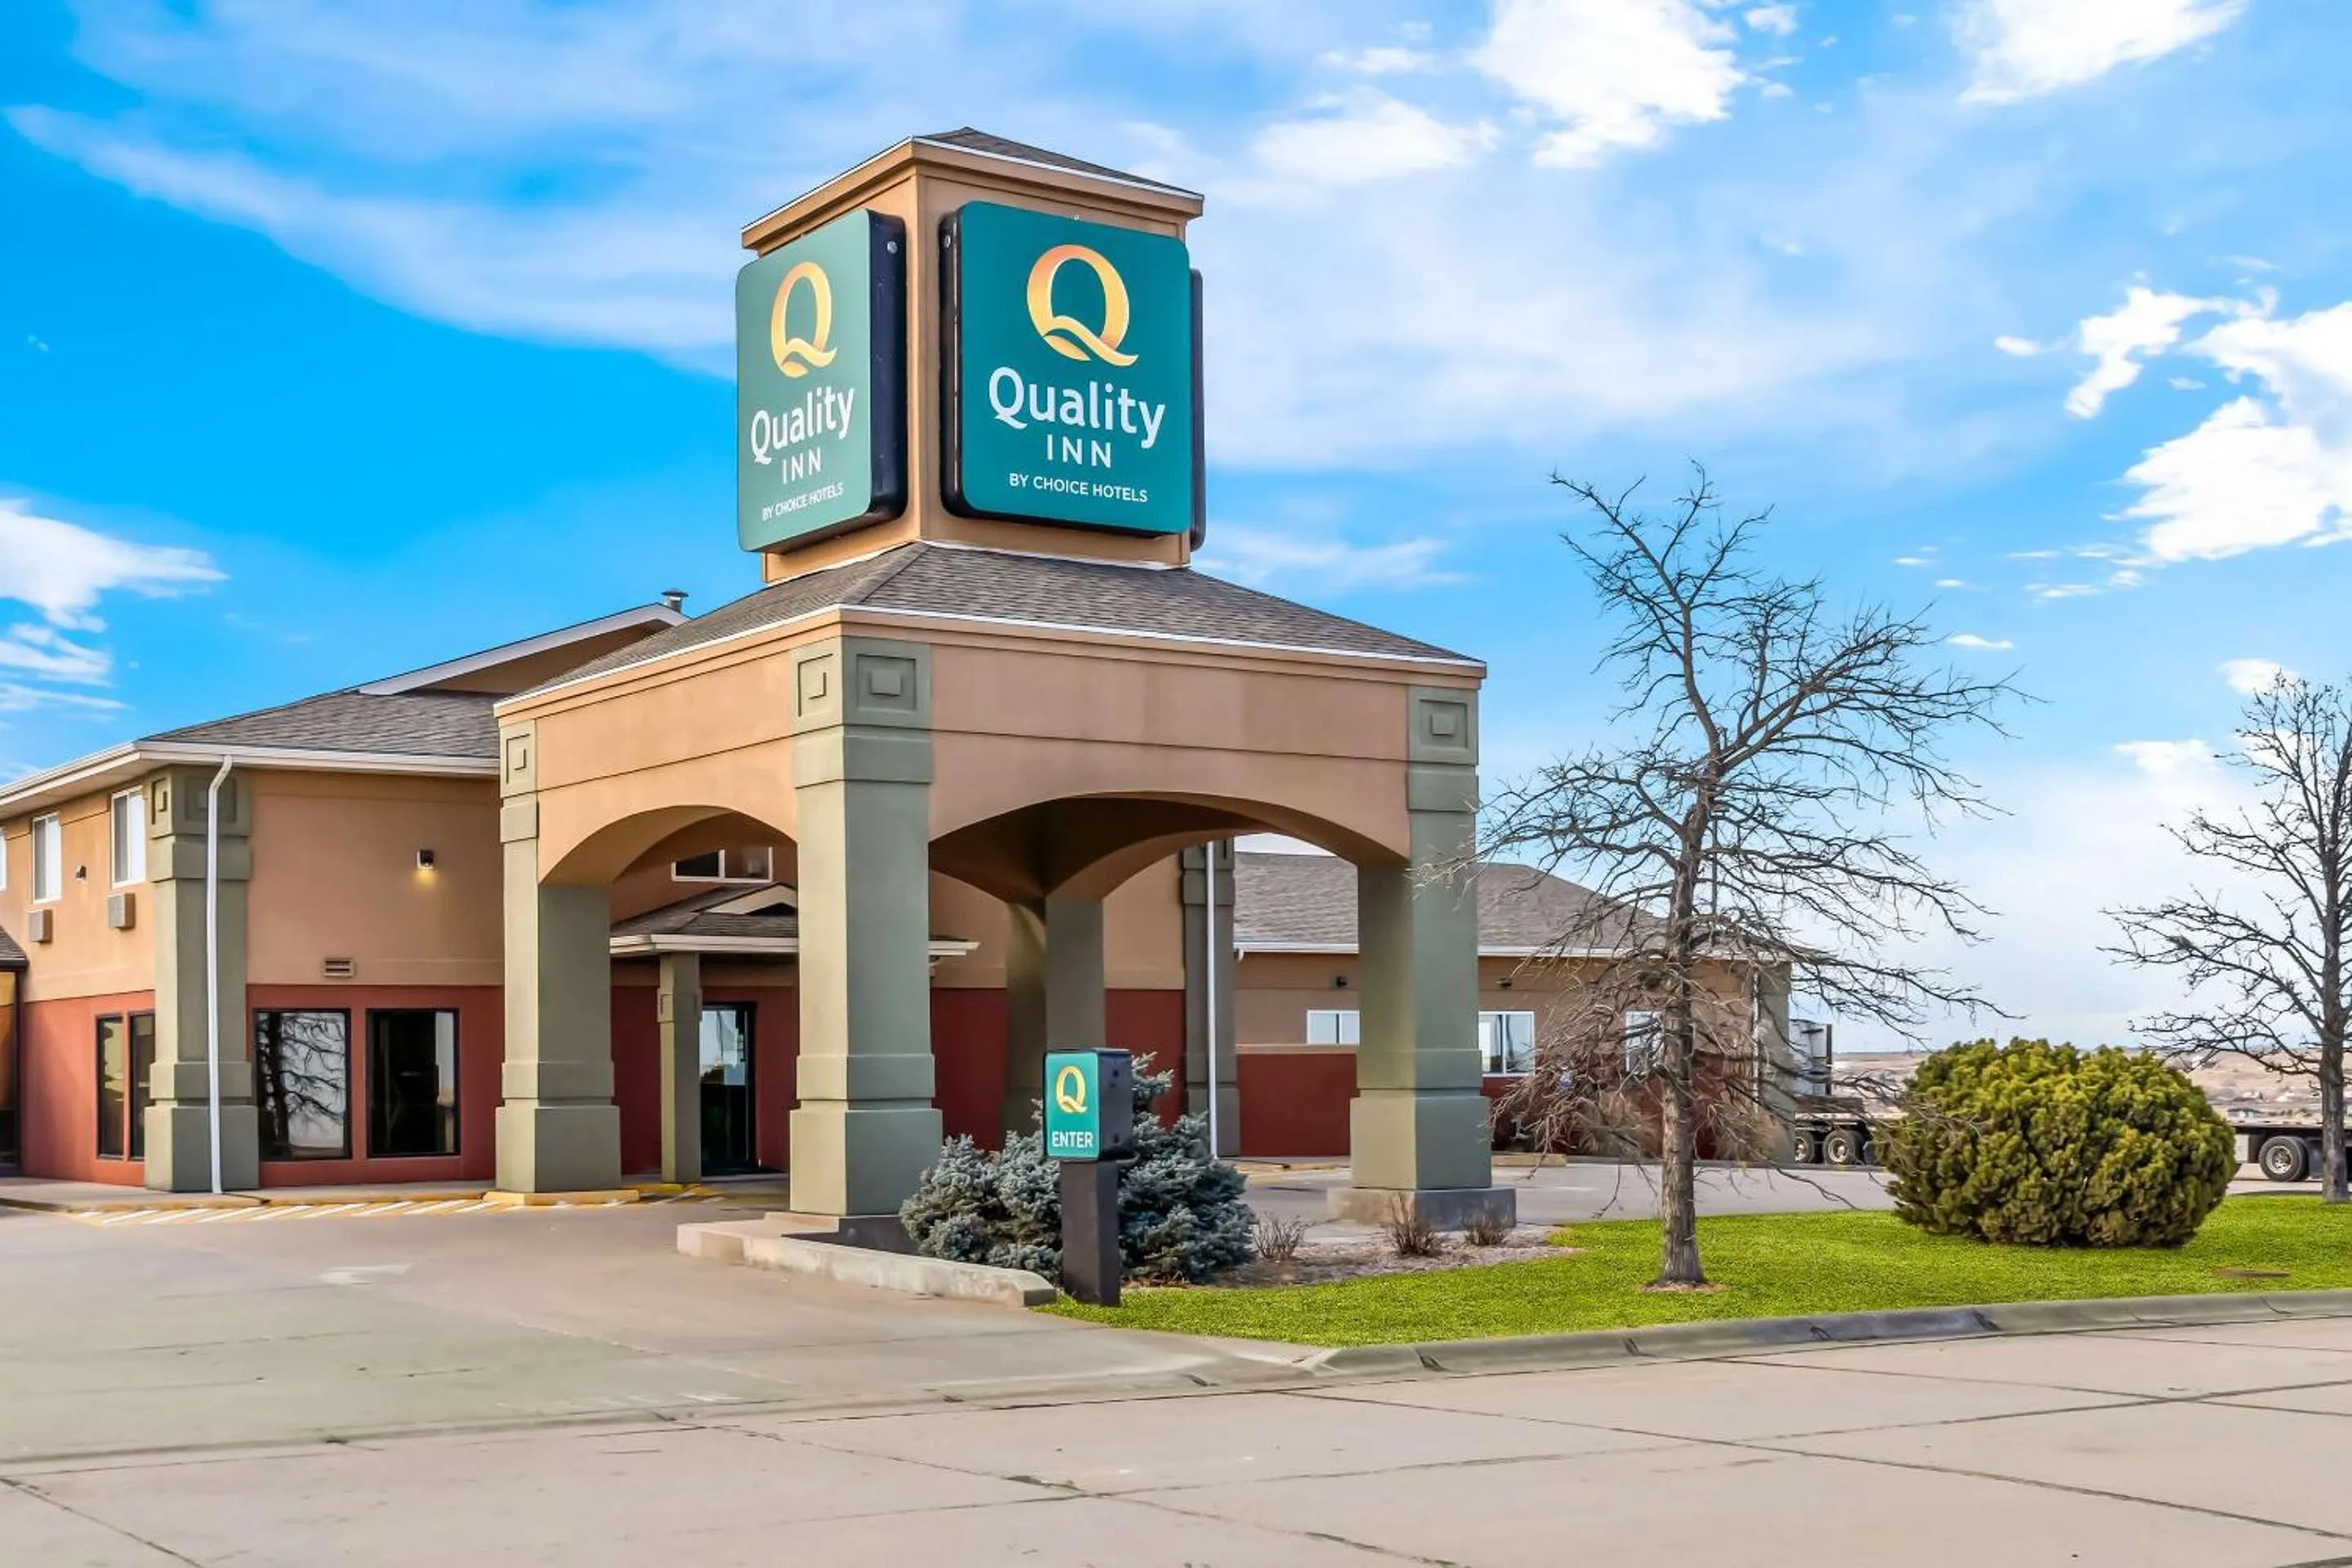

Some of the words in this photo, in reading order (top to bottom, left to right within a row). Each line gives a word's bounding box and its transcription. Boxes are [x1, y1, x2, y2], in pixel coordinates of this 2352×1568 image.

[771, 261, 838, 378] Q
[1026, 244, 1139, 367] Q
[751, 386, 855, 465] Quality
[988, 366, 1166, 449] Quality
[782, 446, 822, 484] INN
[1046, 434, 1111, 469] INN
[762, 505, 773, 521] BY
[775, 494, 808, 515] CHOICE
[808, 482, 844, 505] HOTELS
[1009, 473, 1029, 488] BY
[1033, 475, 1089, 496] CHOICE
[1093, 483, 1148, 503] HOTELS
[1055, 1065, 1088, 1114] Q
[1052, 1130, 1094, 1148] ENTER
